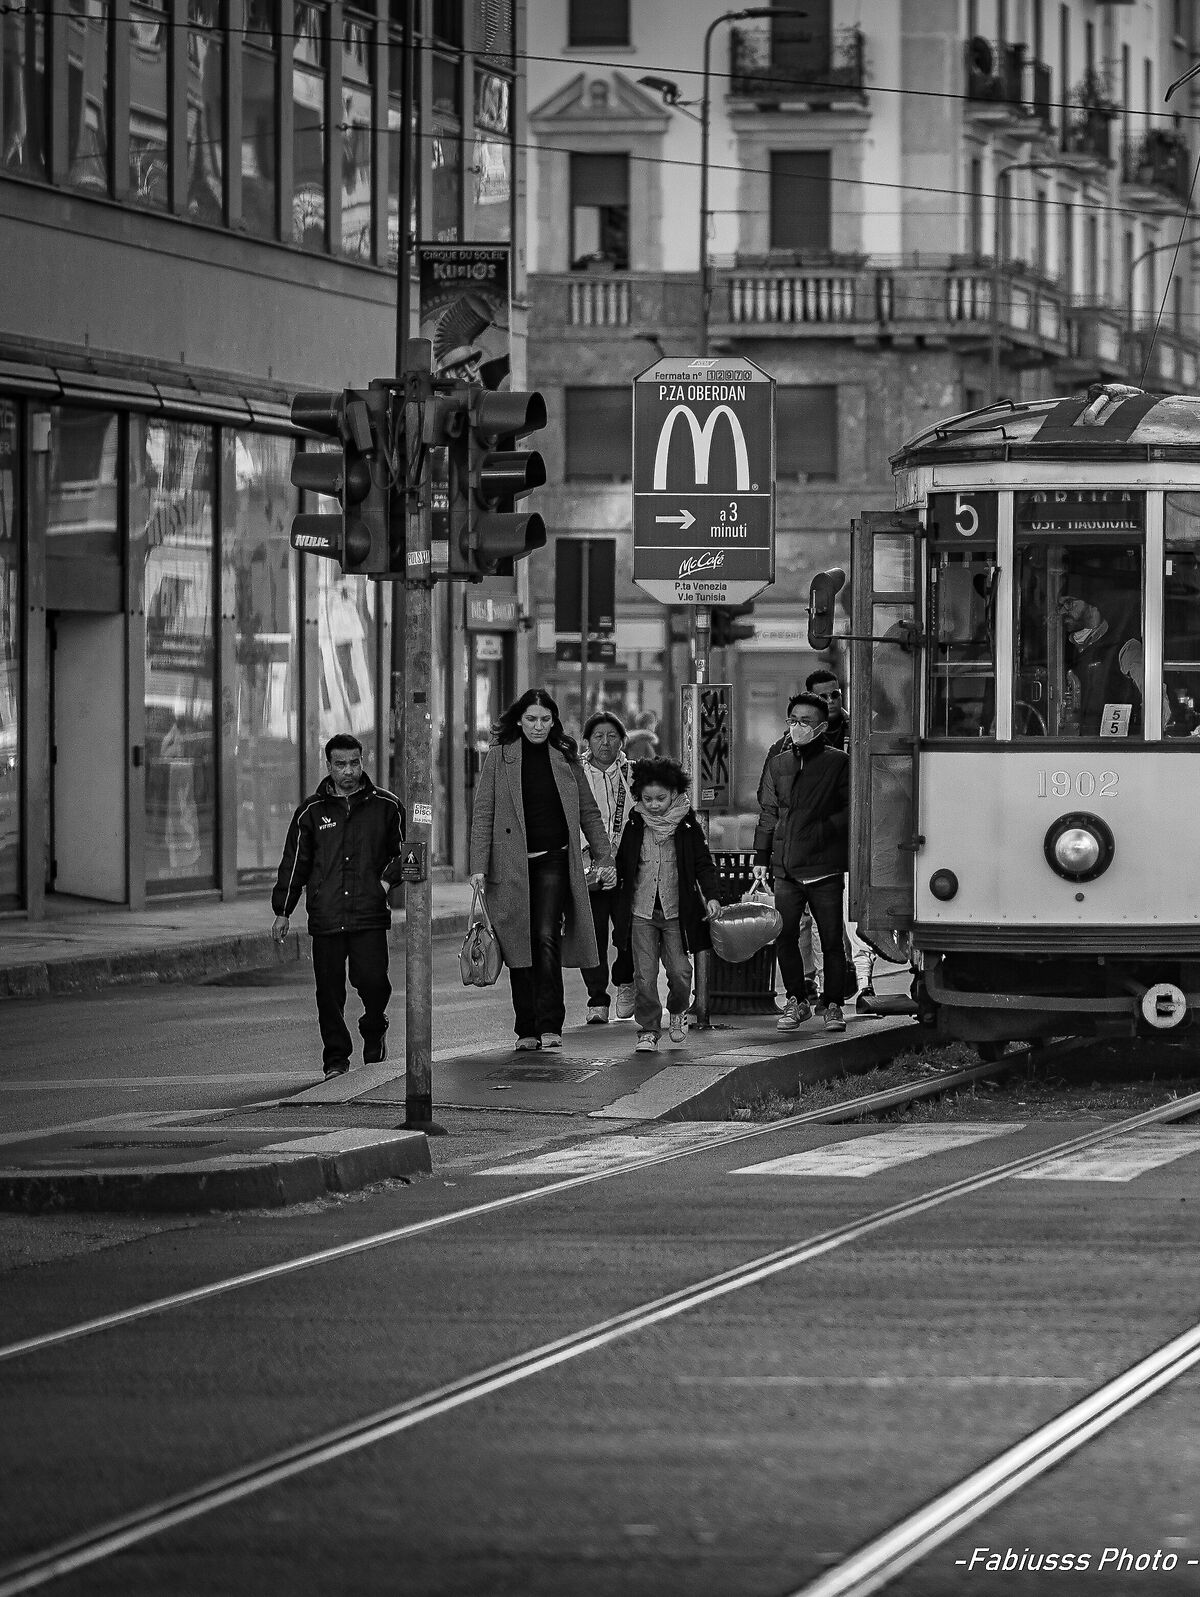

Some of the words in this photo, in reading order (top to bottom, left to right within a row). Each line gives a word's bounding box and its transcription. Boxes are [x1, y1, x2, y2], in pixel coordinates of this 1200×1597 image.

[423, 251, 457, 260] CIRQUE
[459, 251, 473, 260] DU
[474, 251, 505, 260] SOLEIL
[655, 371, 691, 381] Fermata
[706, 370, 753, 381] 12970
[659, 385, 685, 401] P.ZA
[687, 385, 746, 401] OBERDAN
[719, 509, 727, 522] a
[729, 502, 738, 522] 3
[954, 492, 979, 537] 5
[710, 523, 747, 538] minuti
[674, 582, 692, 591] P.ta
[693, 582, 727, 591] Venezia
[678, 592, 695, 602] V.le
[696, 592, 726, 602] Tunisia
[1112, 710, 1121, 720] 5
[1109, 722, 1119, 734] 5
[1037, 770, 1121, 798] 1902
